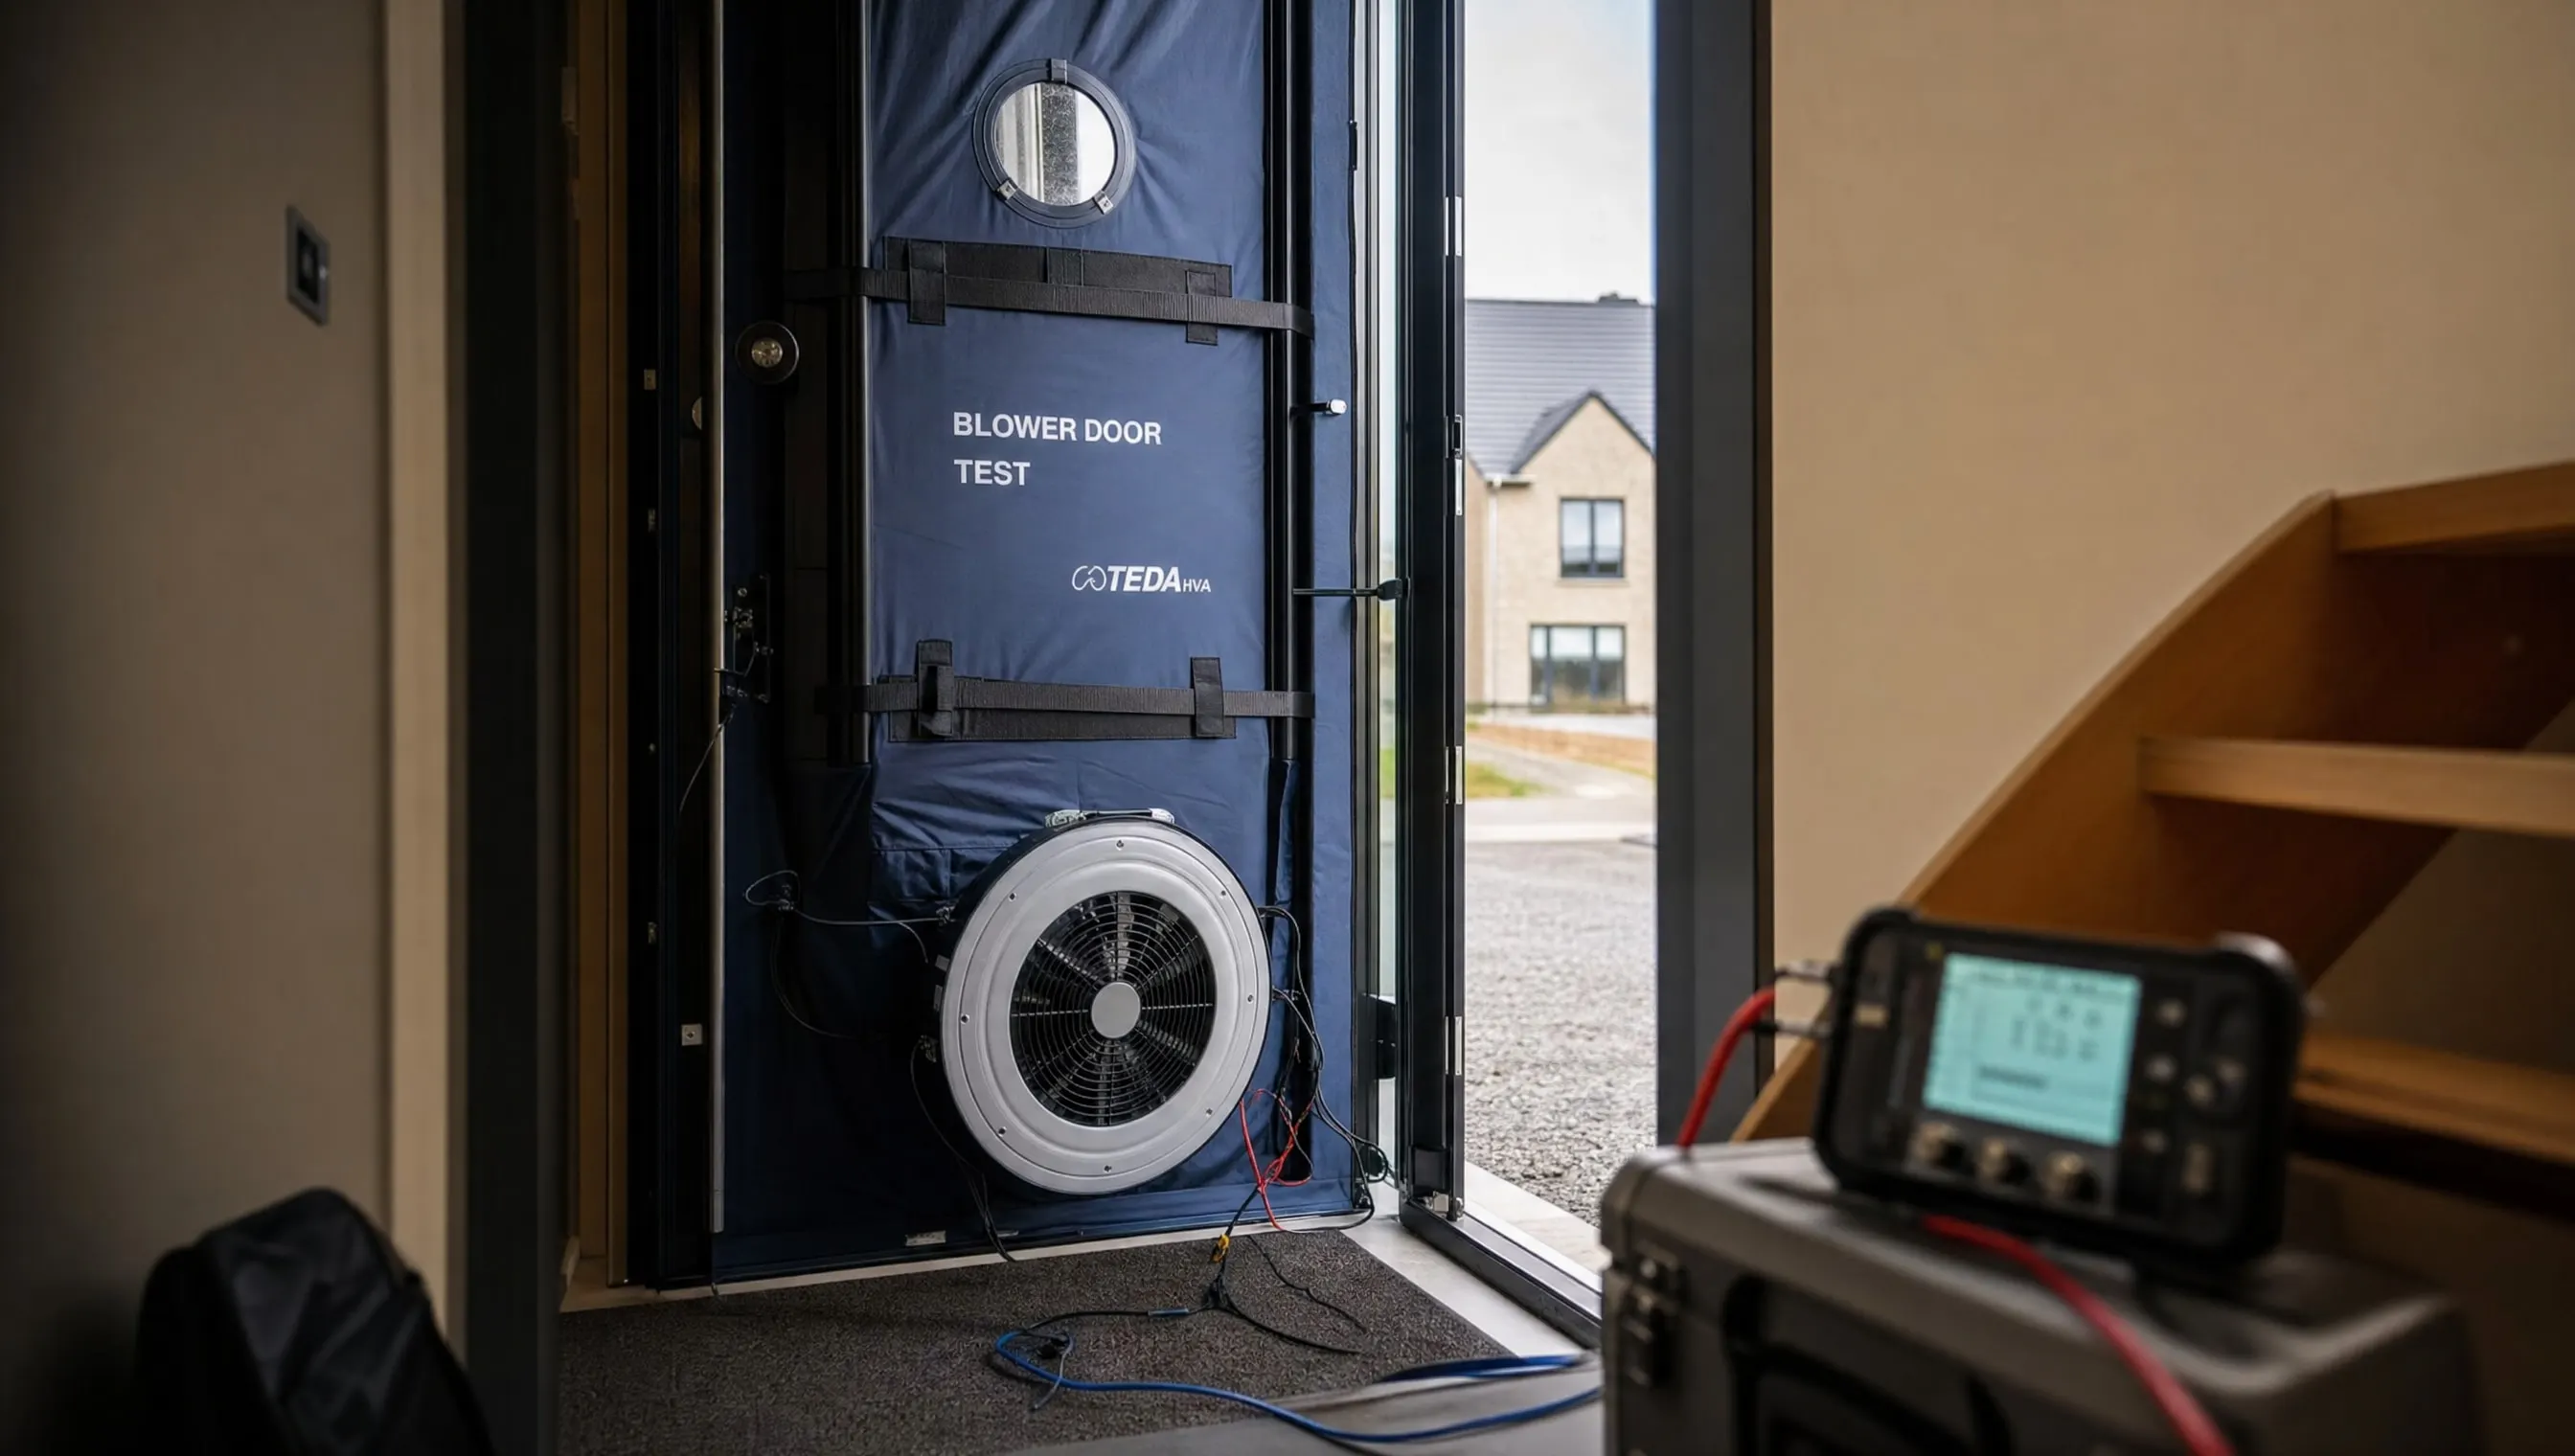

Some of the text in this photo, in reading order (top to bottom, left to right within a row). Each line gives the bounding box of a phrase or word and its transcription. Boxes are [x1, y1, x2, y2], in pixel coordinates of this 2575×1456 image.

[953, 411, 1162, 445] BLOWER DOOR
[953, 459, 1031, 486] TEST
[1107, 565, 1212, 593] TEDA HVA
